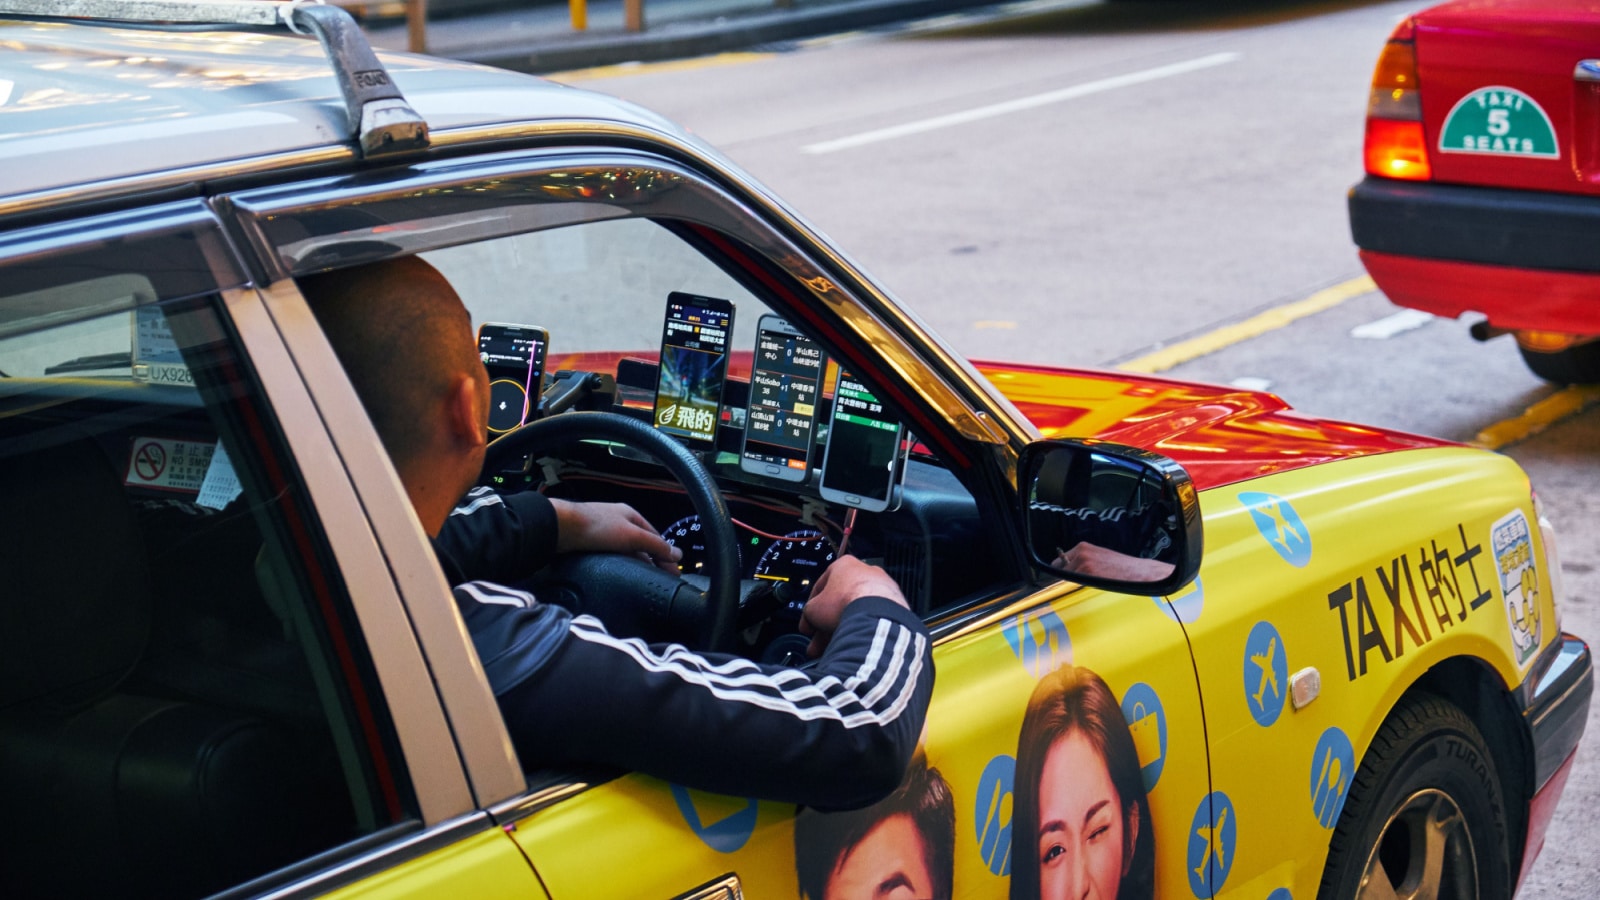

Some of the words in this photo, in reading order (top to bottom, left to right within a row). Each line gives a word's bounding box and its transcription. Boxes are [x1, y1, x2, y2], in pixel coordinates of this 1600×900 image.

[1475, 92, 1524, 111] TAXI
[1487, 108, 1510, 136] 5
[1463, 135, 1533, 153] SEATS
[765, 352, 777, 360] 中心
[786, 348, 792, 357] 0
[677, 406, 713, 431] 飛的
[777, 418, 783, 428] 0
[172, 456, 184, 465] NO
[676, 528, 687, 536] 60
[690, 523, 701, 531] 80
[764, 566, 770, 574] 1
[772, 552, 780, 560] 2
[785, 541, 793, 550] 3
[814, 542, 822, 550] 5
[826, 552, 833, 560] 6
